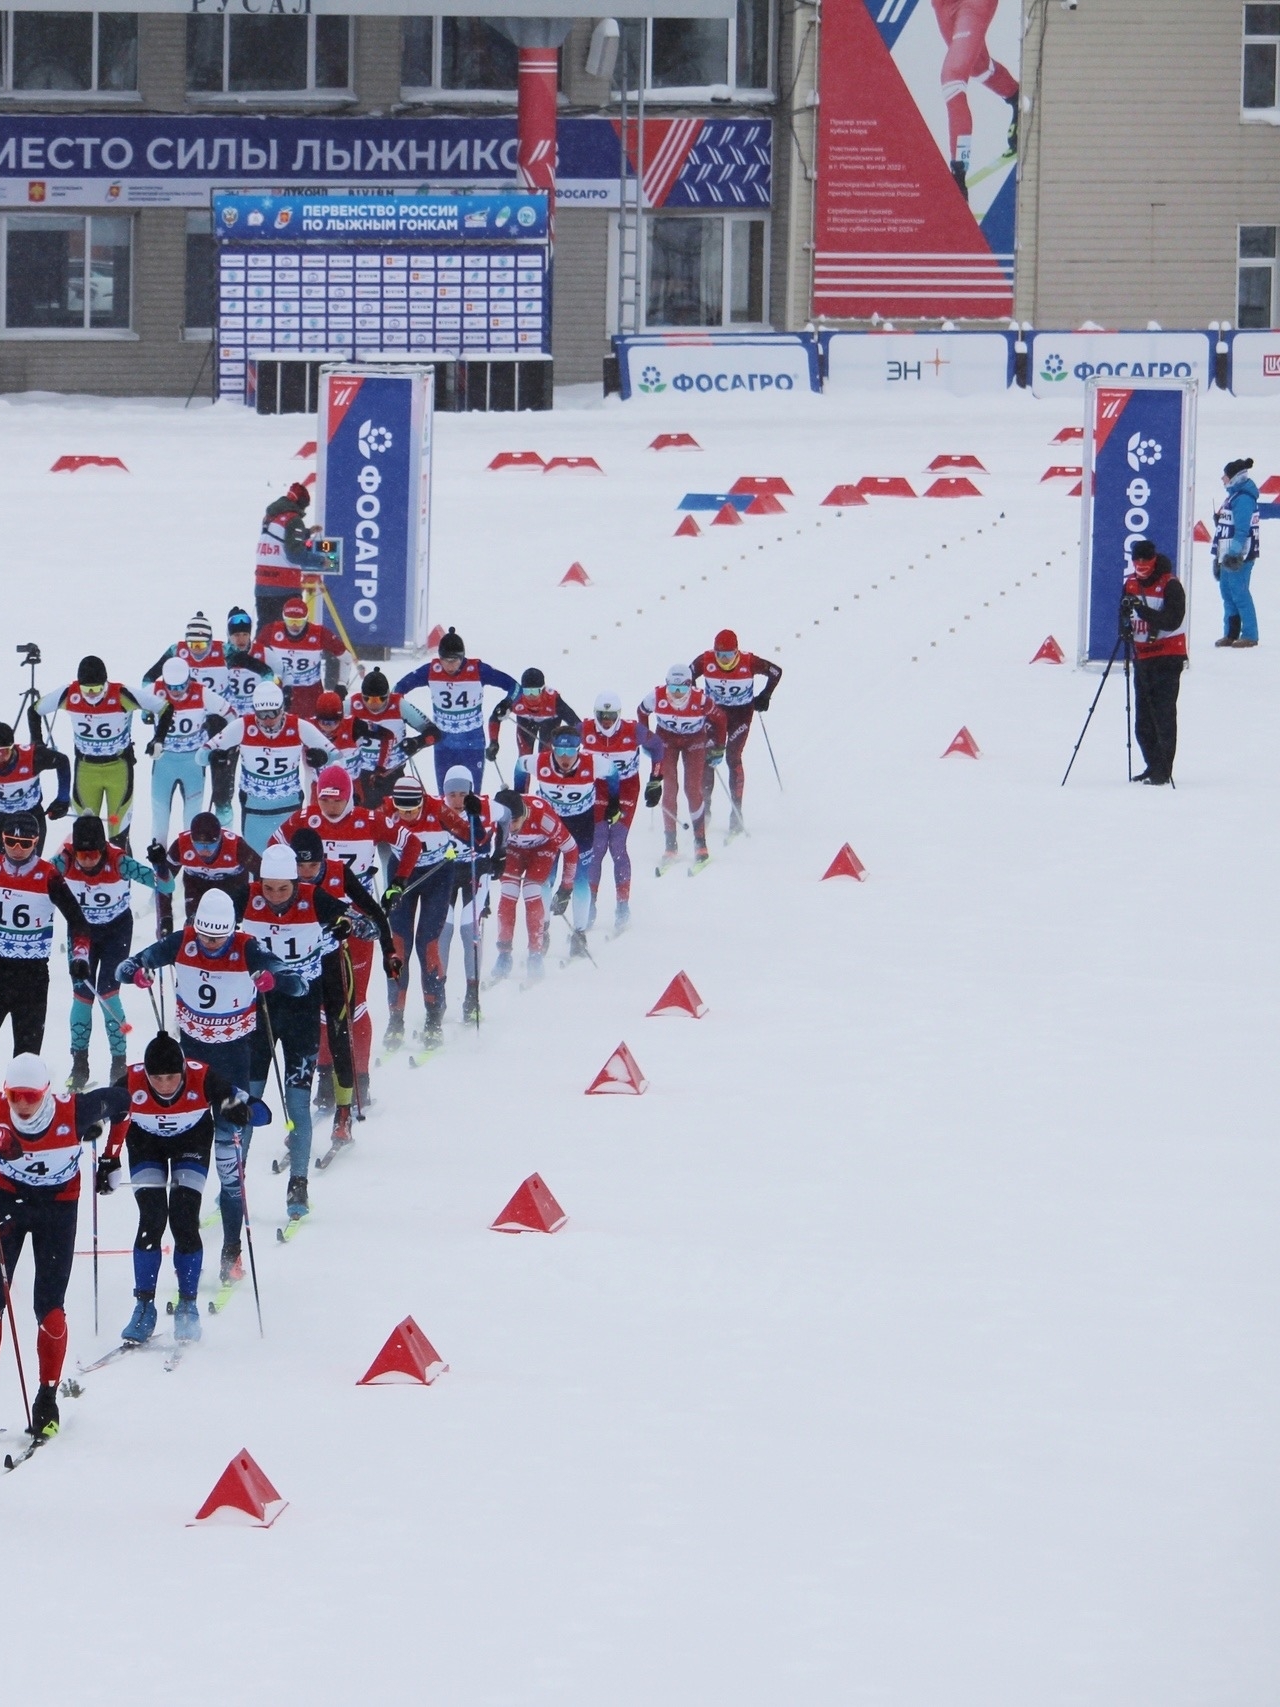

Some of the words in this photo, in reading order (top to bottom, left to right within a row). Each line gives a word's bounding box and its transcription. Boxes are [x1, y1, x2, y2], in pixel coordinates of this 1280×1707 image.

[146, 138, 277, 171] СИЛЫ
[303, 205, 395, 217] ПЕРВЕНСТВО
[399, 205, 458, 217] РОССИИ
[303, 219, 322, 231] ПО
[326, 219, 396, 231] ЛЫЖНЫМ
[399, 219, 458, 231] ГОНКАМ
[887, 361, 920, 381] ЭН
[1073, 362, 1192, 381] ФОСАГРО
[353, 465, 382, 624] ФОСАГРО
[439, 691, 469, 709] 34
[78, 722, 112, 738] 26
[255, 757, 288, 775] 25
[77, 892, 111, 906] 19
[198, 984, 217, 1009] 9
[233, 998, 239, 1008] 1
[24, 1161, 49, 1176] 4
